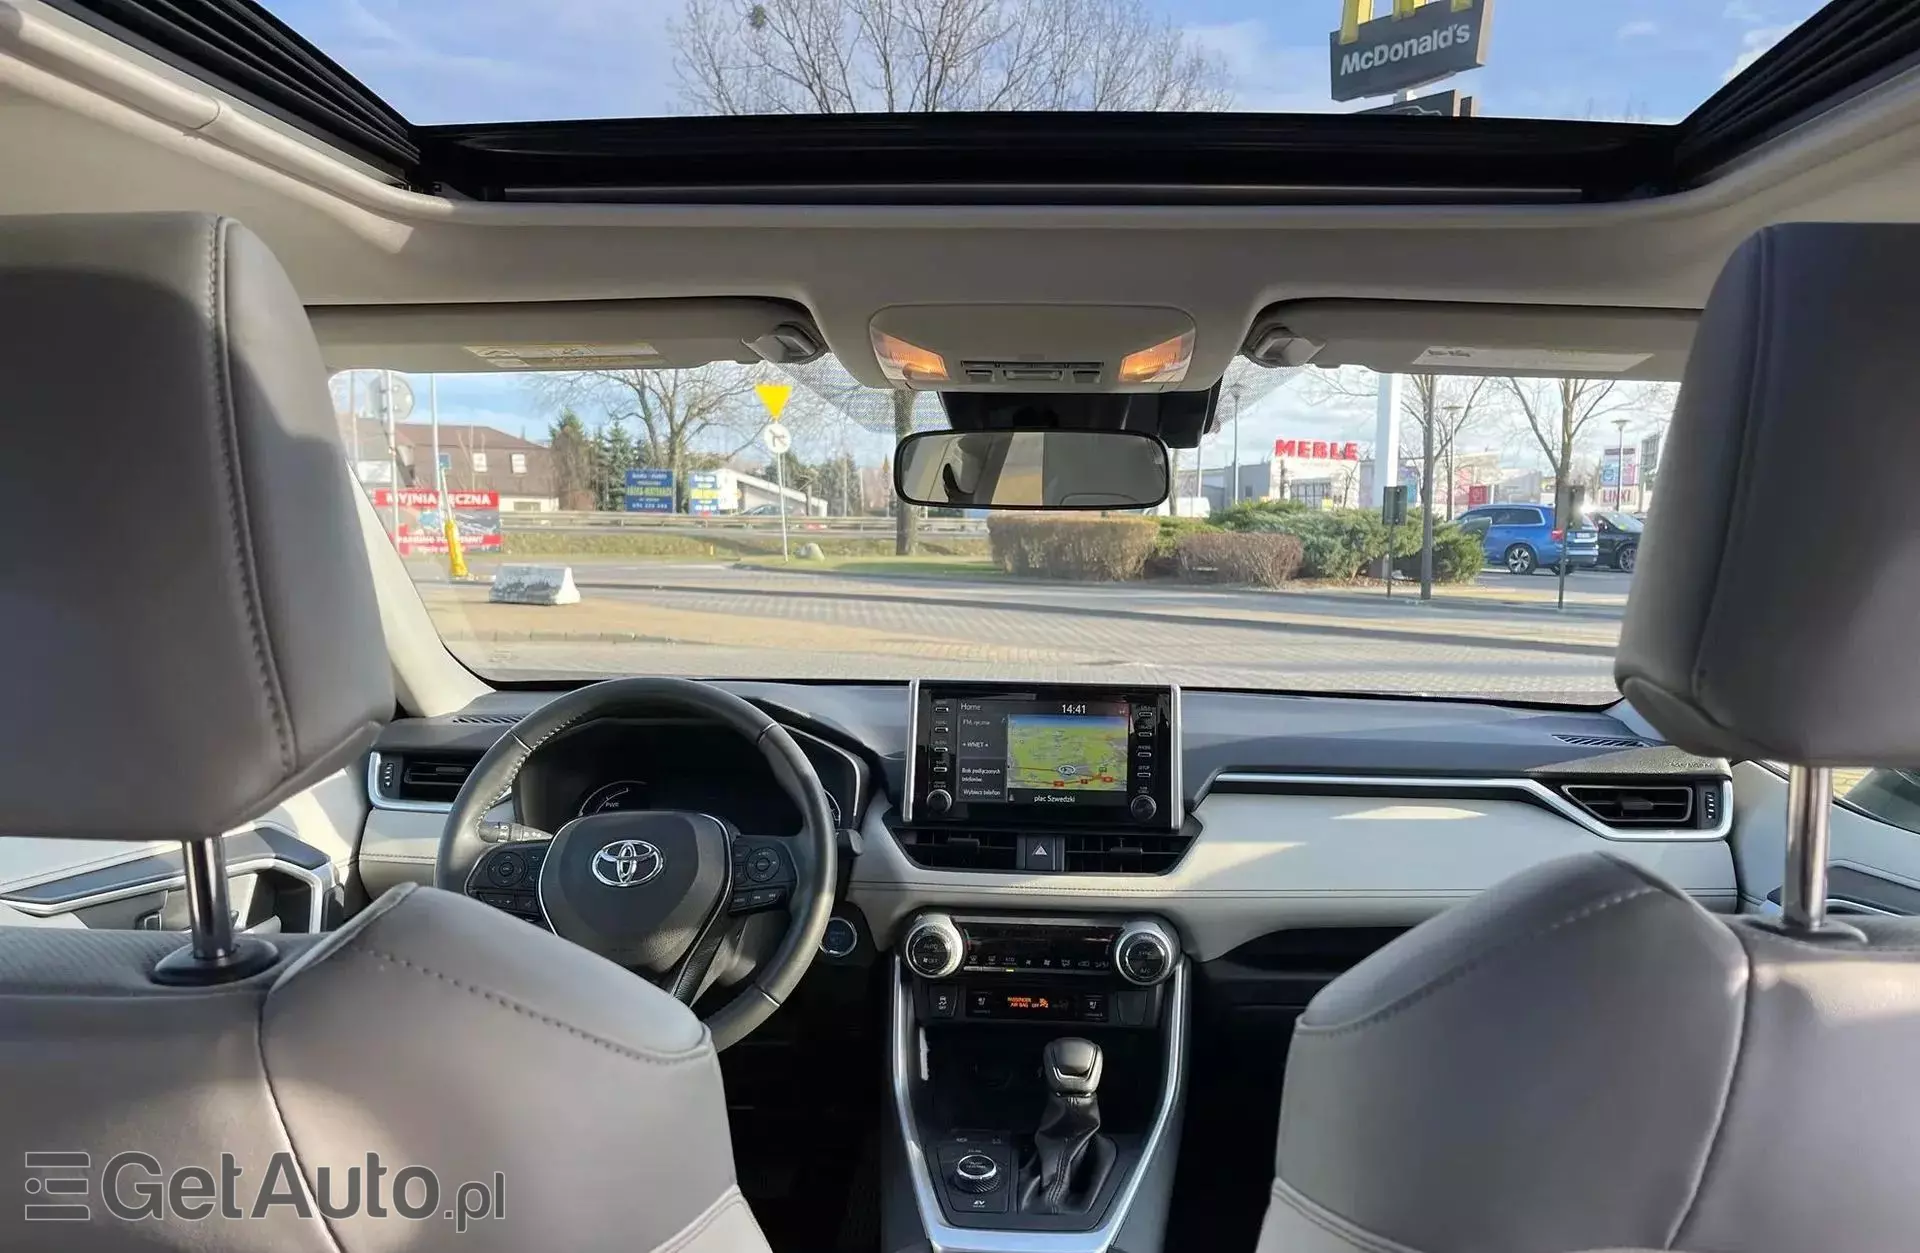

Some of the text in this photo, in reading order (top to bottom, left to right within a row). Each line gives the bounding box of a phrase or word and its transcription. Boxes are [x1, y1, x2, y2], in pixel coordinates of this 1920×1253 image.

[1340, 24, 1471, 76] McDonald's
[1274, 438, 1360, 461] MEBLE
[960, 702, 981, 711] Home
[1061, 704, 1086, 714] 14:41
[1033, 794, 1076, 804] plac Szwedzki
